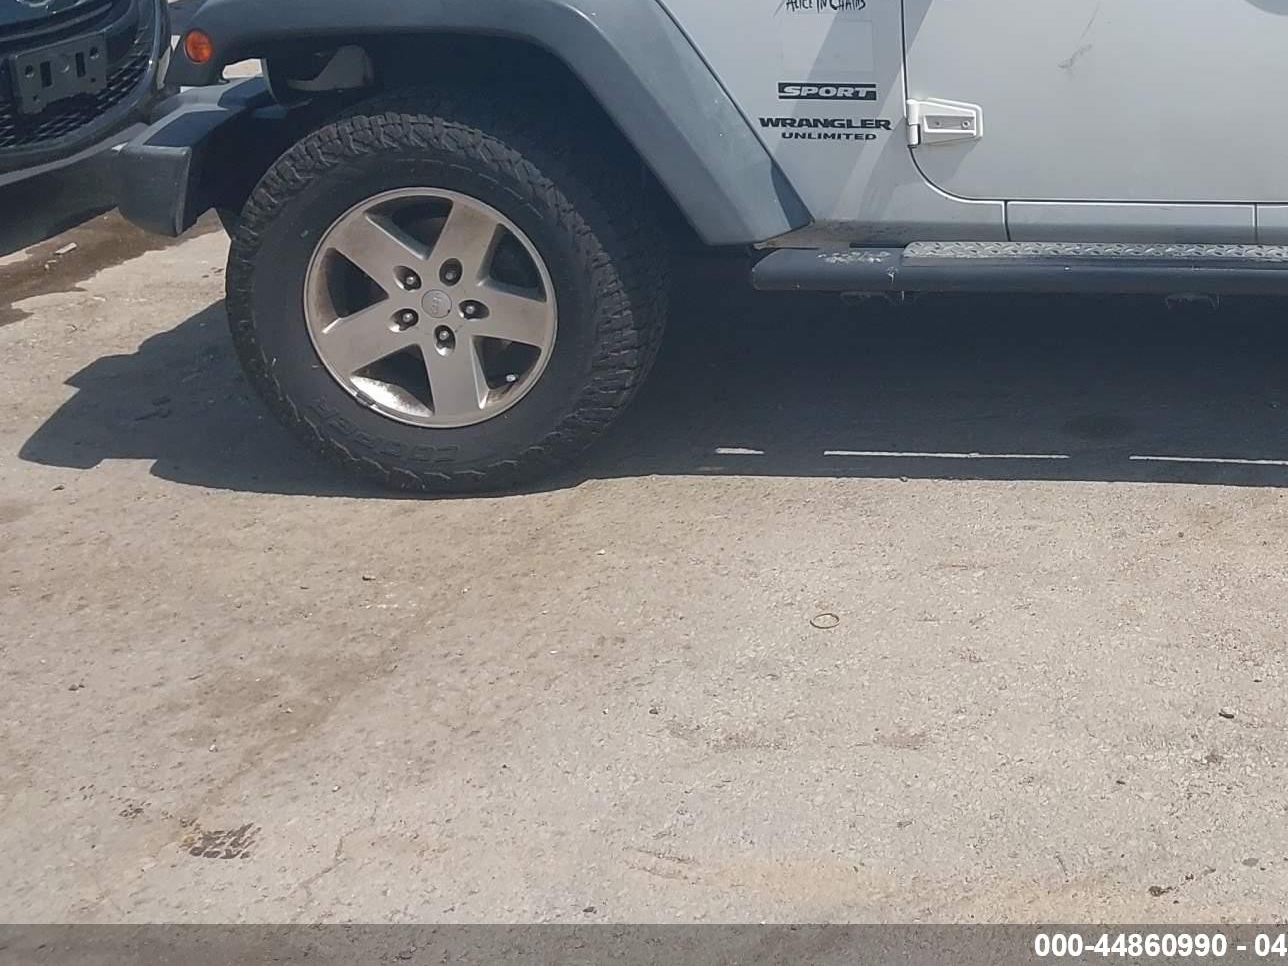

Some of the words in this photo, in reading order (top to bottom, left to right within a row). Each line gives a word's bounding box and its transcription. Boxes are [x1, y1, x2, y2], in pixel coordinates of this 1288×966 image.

[783, 86, 876, 98] SPORT
[759, 117, 893, 131] WRANGLER
[781, 132, 877, 141] UNLIMITED
